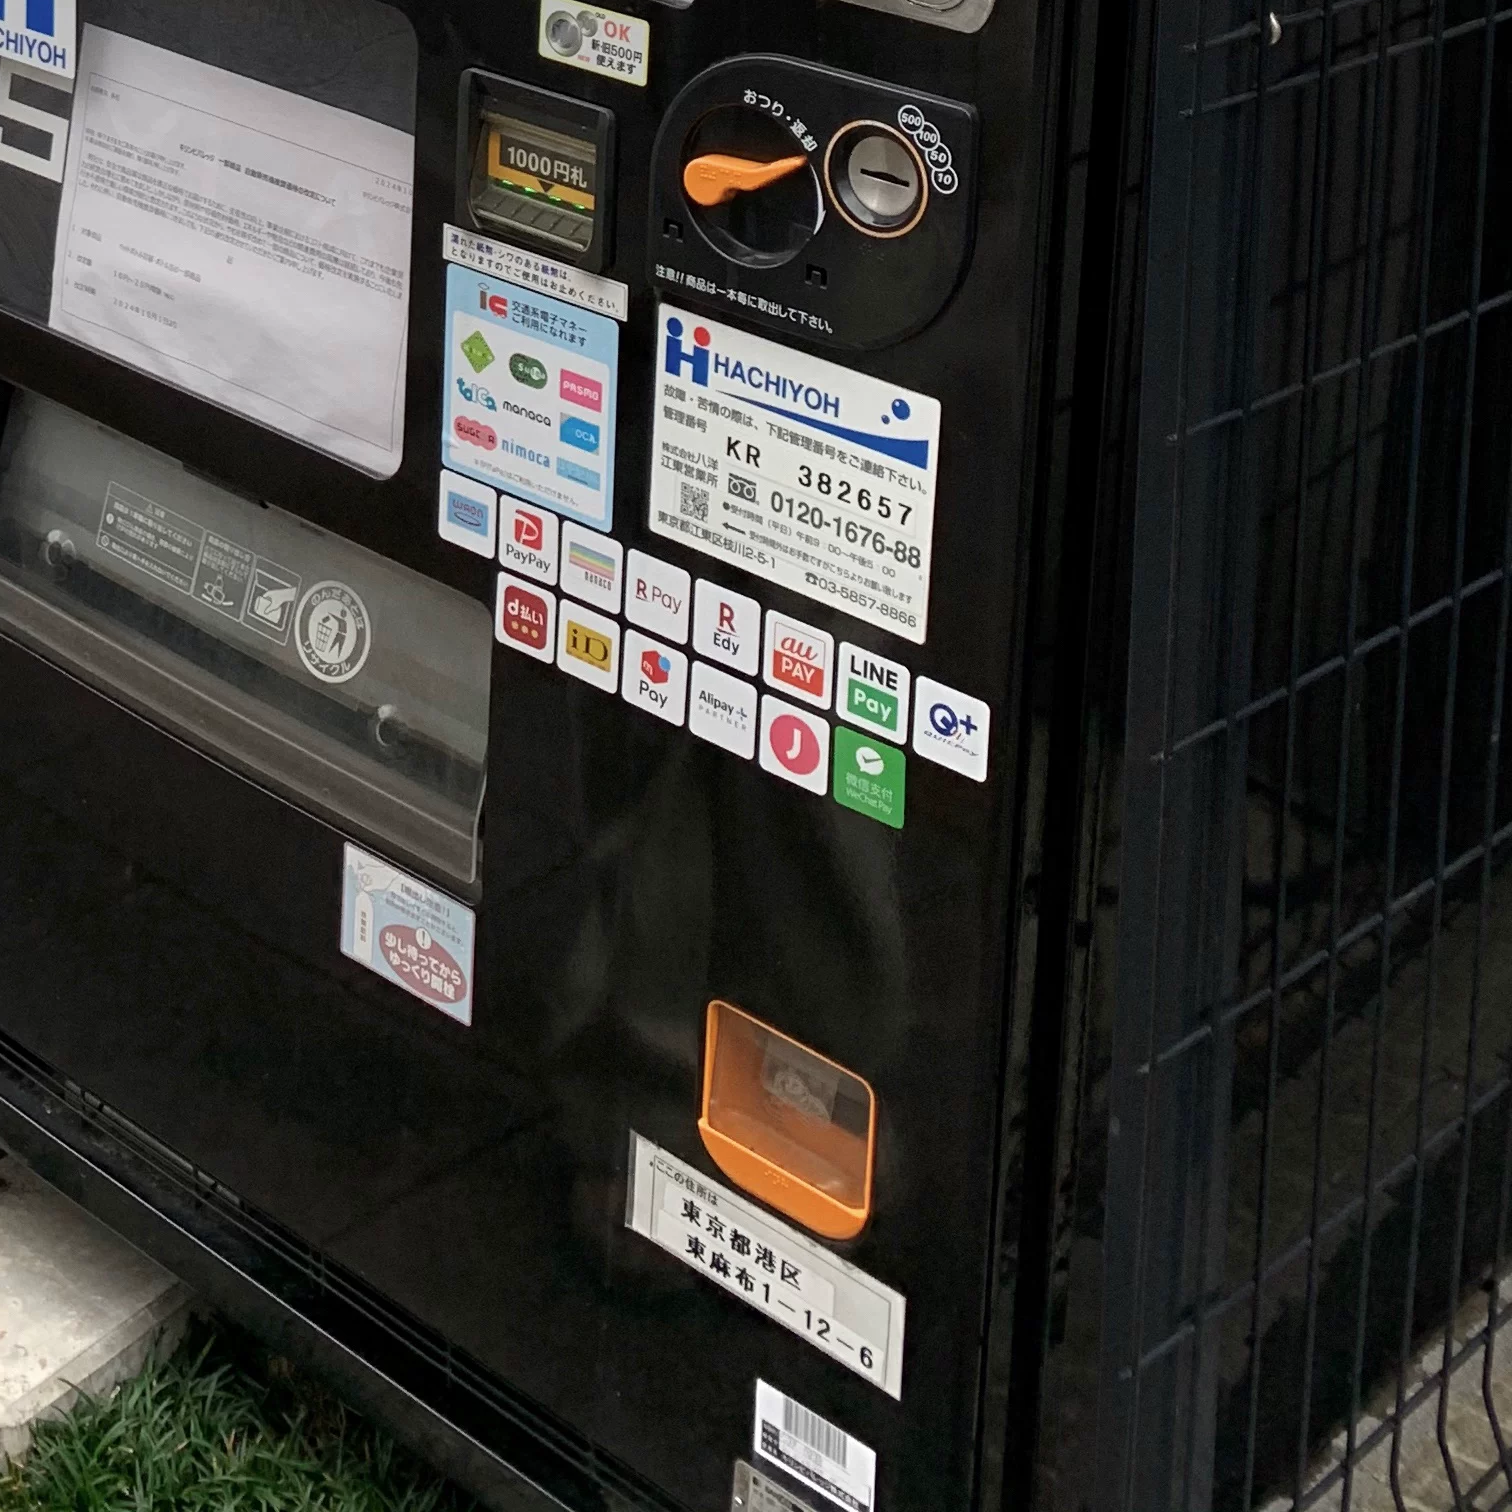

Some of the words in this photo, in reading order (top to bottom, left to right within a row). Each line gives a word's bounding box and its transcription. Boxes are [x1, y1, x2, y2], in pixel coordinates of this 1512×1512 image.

[595, 12, 606, 20] OLD
[603, 20, 631, 43] OK
[591, 38, 643, 66] 新旧500円
[596, 54, 637, 76] 使えます
[901, 112, 922, 128] 500
[919, 129, 938, 144] 100
[507, 146, 588, 189] 1000円札
[930, 149, 947, 163] 50
[938, 172, 952, 187] 10
[511, 300, 588, 333] 交通系電子マネー
[511, 311, 587, 347] ご利用になれます
[562, 380, 601, 402] PASMO
[714, 353, 840, 418] HACHIYOH
[502, 400, 552, 427] manaca
[663, 405, 708, 434] 管理番号
[501, 438, 551, 469] nimoca
[661, 441, 719, 472] 株式会社八洋
[660, 455, 719, 489] 江東営業所
[798, 464, 913, 526] 382657
[657, 510, 776, 570] 東京都江東区枝川2-5-1
[770, 491, 922, 569] 0120-1676-88
[506, 543, 551, 574] PayPay
[584, 571, 612, 591] nanaco
[636, 577, 648, 600] R
[651, 585, 682, 615] Pay
[507, 599, 544, 626] d払い
[718, 601, 738, 634] R
[302, 640, 352, 676] リサイクル
[571, 628, 609, 662] iD
[713, 632, 740, 656] Edy
[780, 636, 818, 661] au
[781, 656, 816, 684] PAY
[850, 654, 899, 692] LINE
[639, 680, 669, 709] Pay
[853, 687, 892, 723] Pay
[698, 704, 748, 732] PARTNER
[785, 727, 802, 760] J
[845, 772, 894, 803] 微信支付
[845, 787, 879, 809] WeChat
[878, 800, 893, 815] Pay
[384, 931, 462, 986] 少し待ってから
[655, 1160, 719, 1207] ここの住所は
[680, 1197, 803, 1291] 東京都港区
